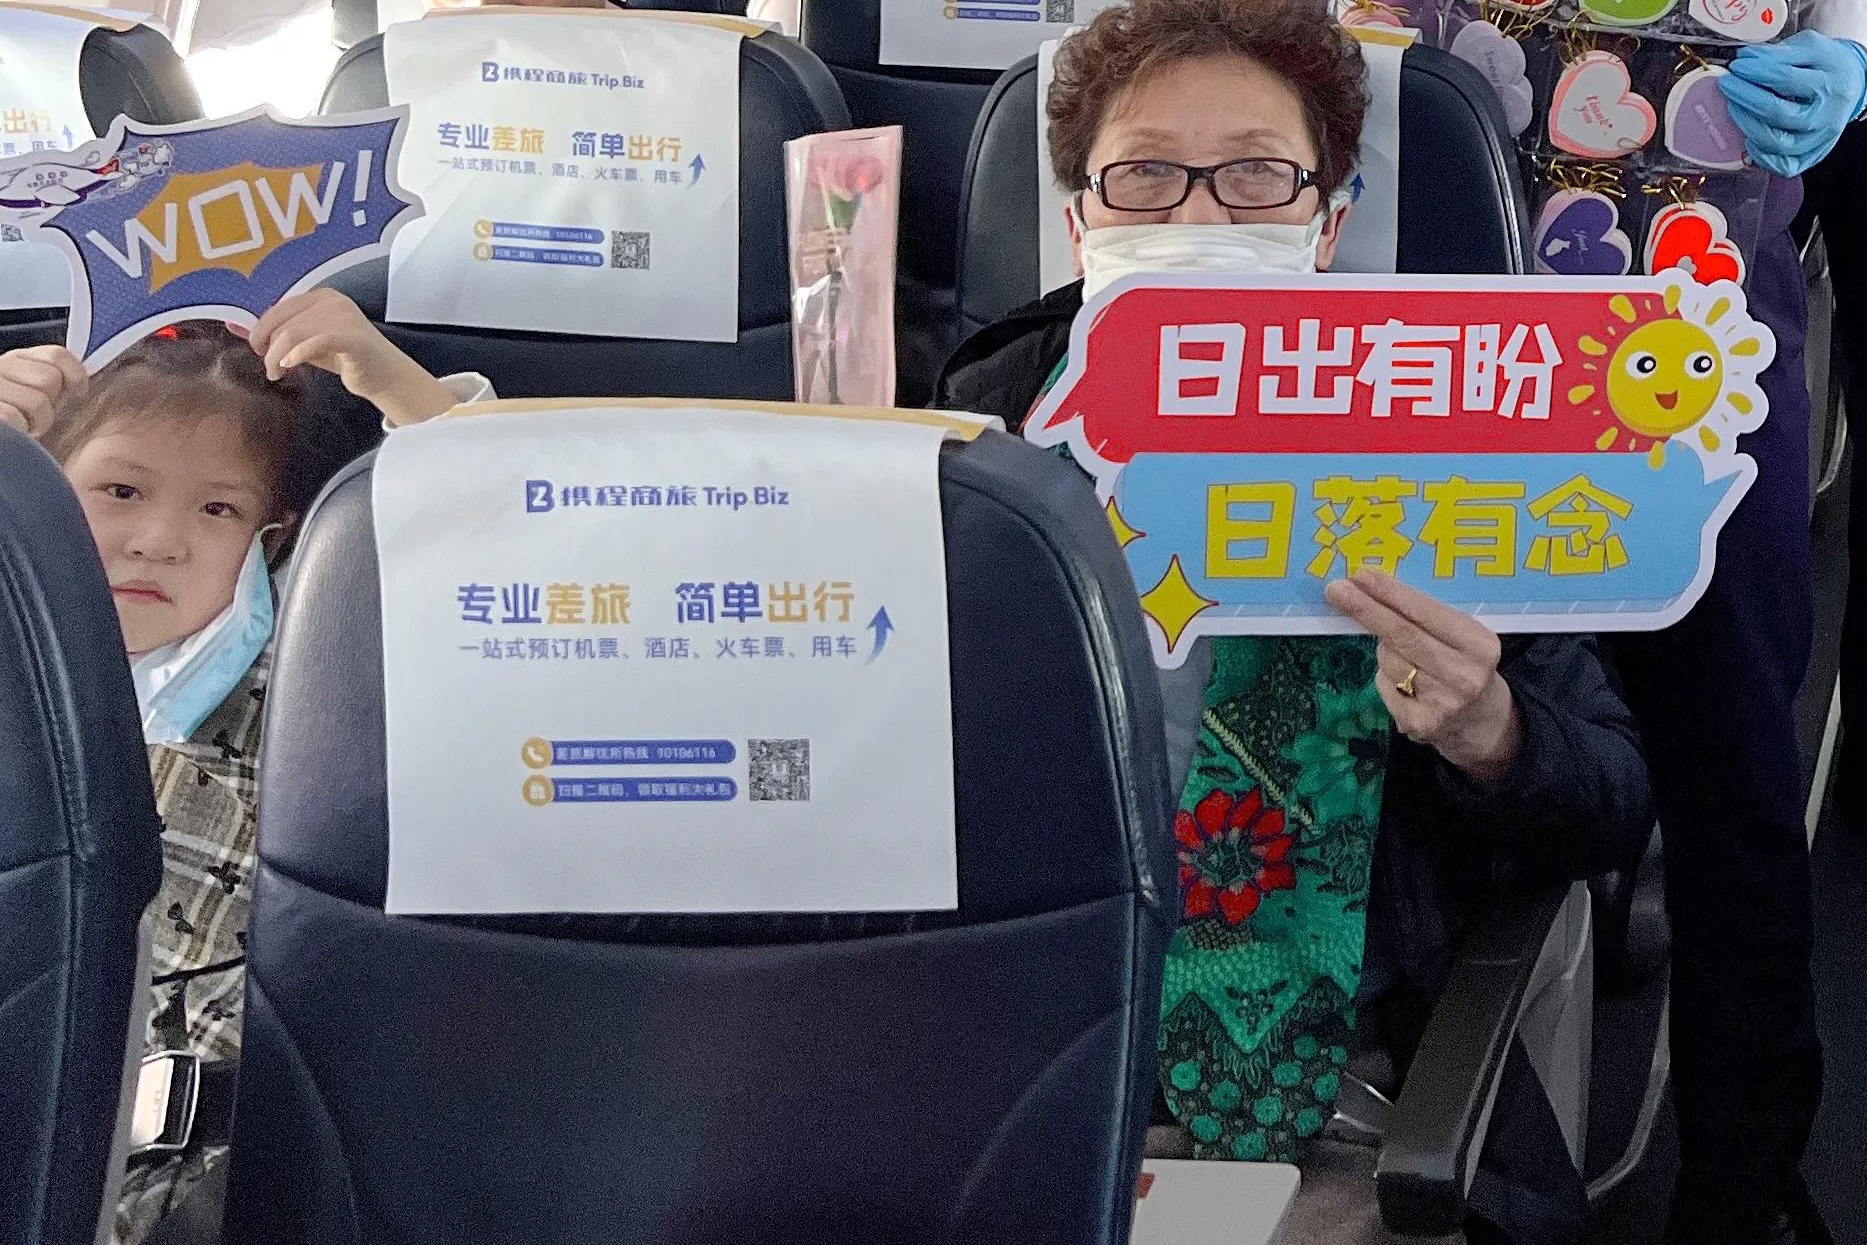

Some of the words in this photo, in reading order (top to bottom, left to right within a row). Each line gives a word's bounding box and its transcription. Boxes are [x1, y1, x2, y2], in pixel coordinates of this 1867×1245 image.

[438, 121, 545, 155] 专业差旅
[571, 130, 682, 164] 简单出行
[85, 149, 373, 280] WOW!
[1156, 318, 1566, 421] 日出有盼
[560, 484, 698, 507] 携程商旅
[702, 485, 791, 511] Trip.Biz
[1202, 474, 1635, 581] 日落有念
[457, 582, 632, 626] 专业差旅
[675, 581, 856, 624] 简单出行
